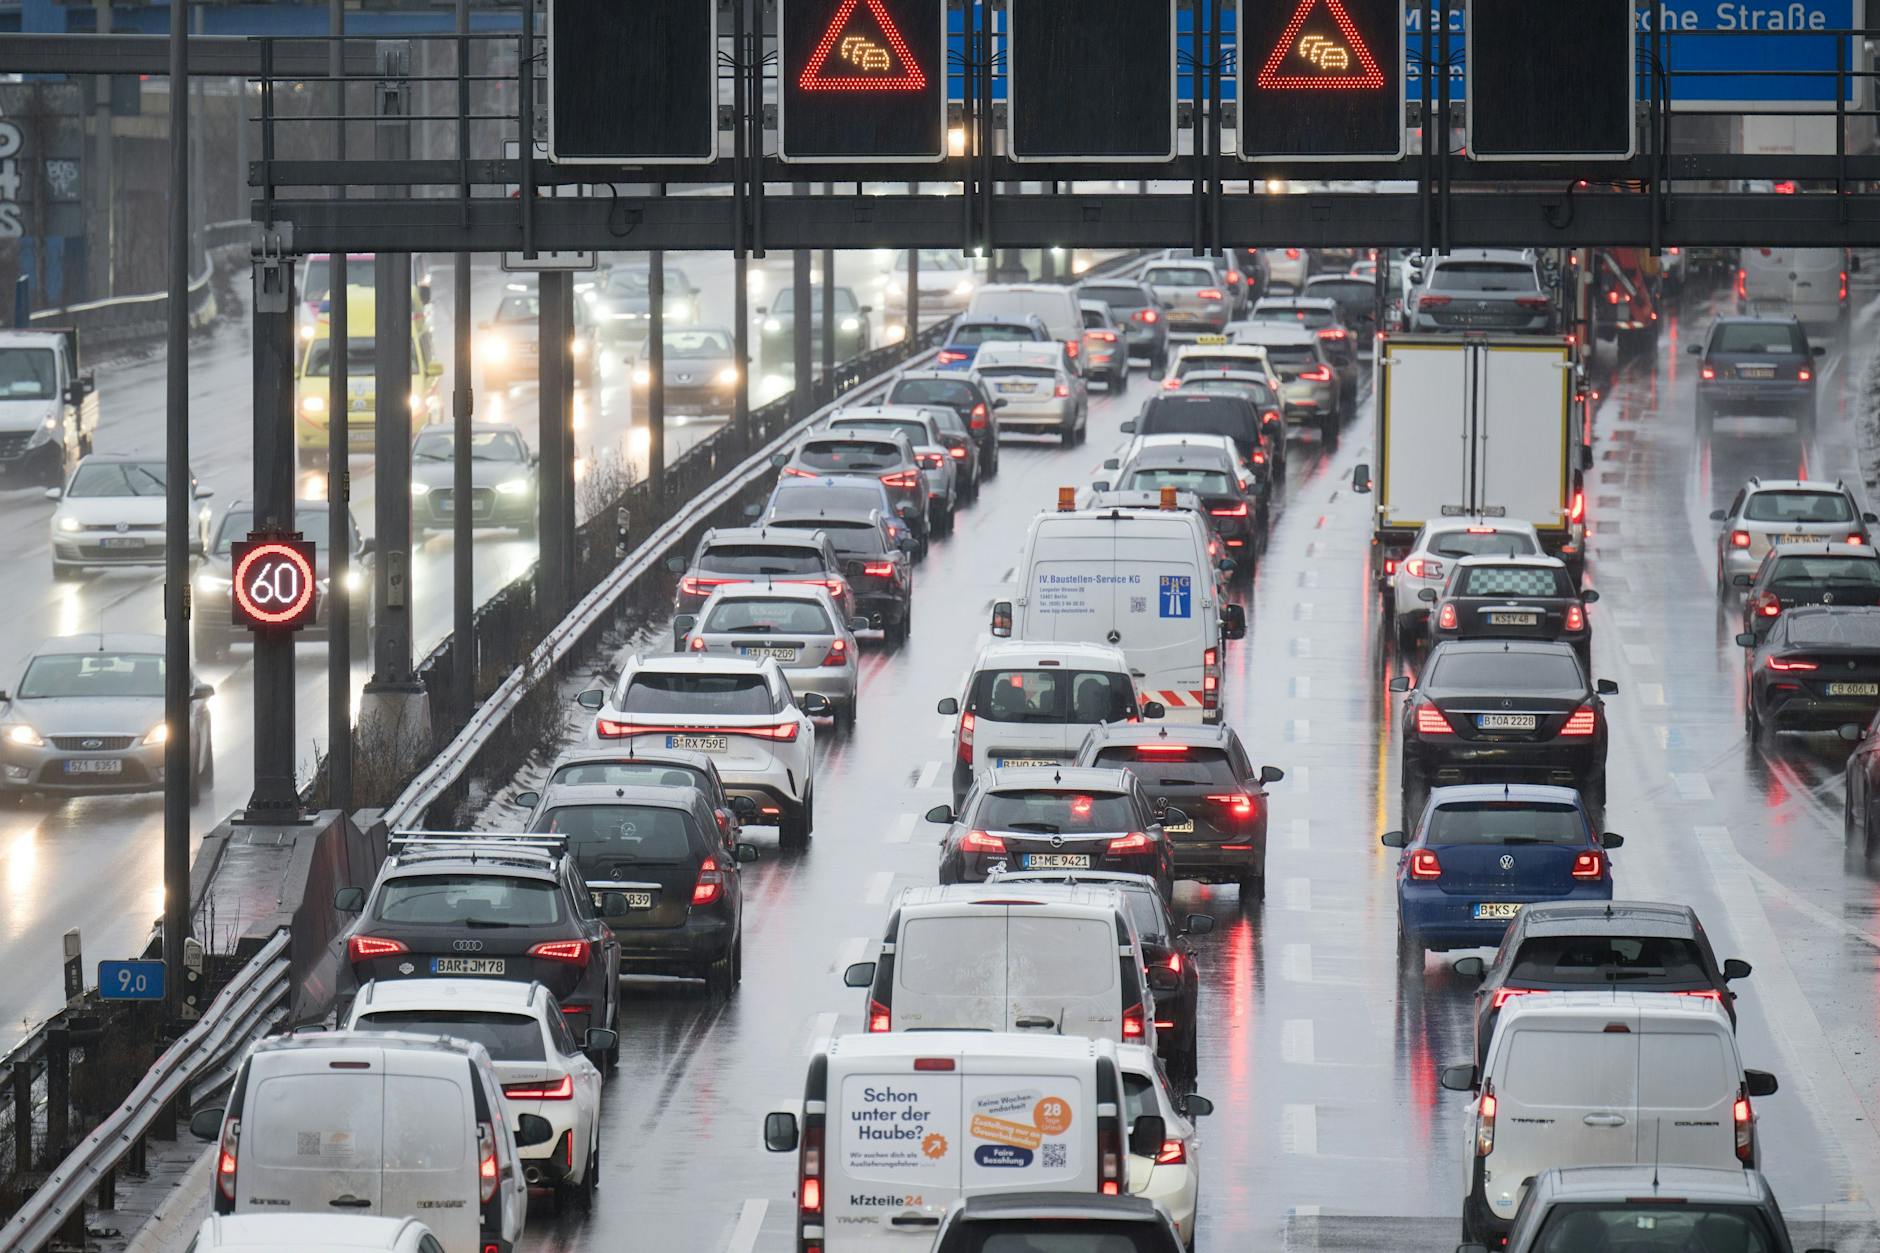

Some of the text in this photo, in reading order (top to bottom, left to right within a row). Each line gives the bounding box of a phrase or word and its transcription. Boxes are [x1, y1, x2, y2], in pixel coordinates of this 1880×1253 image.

[1405, 9, 1466, 31] Mec
[1716, 3, 1826, 31] Straße
[251, 563, 297, 603] 60
[1051, 575, 1127, 584] Baustellen-Service
[1129, 575, 1140, 584] KG
[1511, 716, 1534, 726] 2228
[1044, 855, 1059, 866] ME
[1061, 855, 1088, 867] 9421
[1495, 904, 1510, 915] KS
[437, 959, 503, 974] BAR JM 78
[118, 969, 146, 993] 9,0
[863, 1086, 918, 1103] Schon
[851, 1106, 930, 1122] unter der
[1043, 1103, 1062, 1117] 28
[858, 1124, 924, 1141] Haube?
[994, 1149, 1014, 1157] Faire
[850, 1160, 919, 1169] Auslieferungsfahrer
[983, 1156, 1024, 1167] Bezahlung
[850, 1194, 923, 1207] kfzteile24
